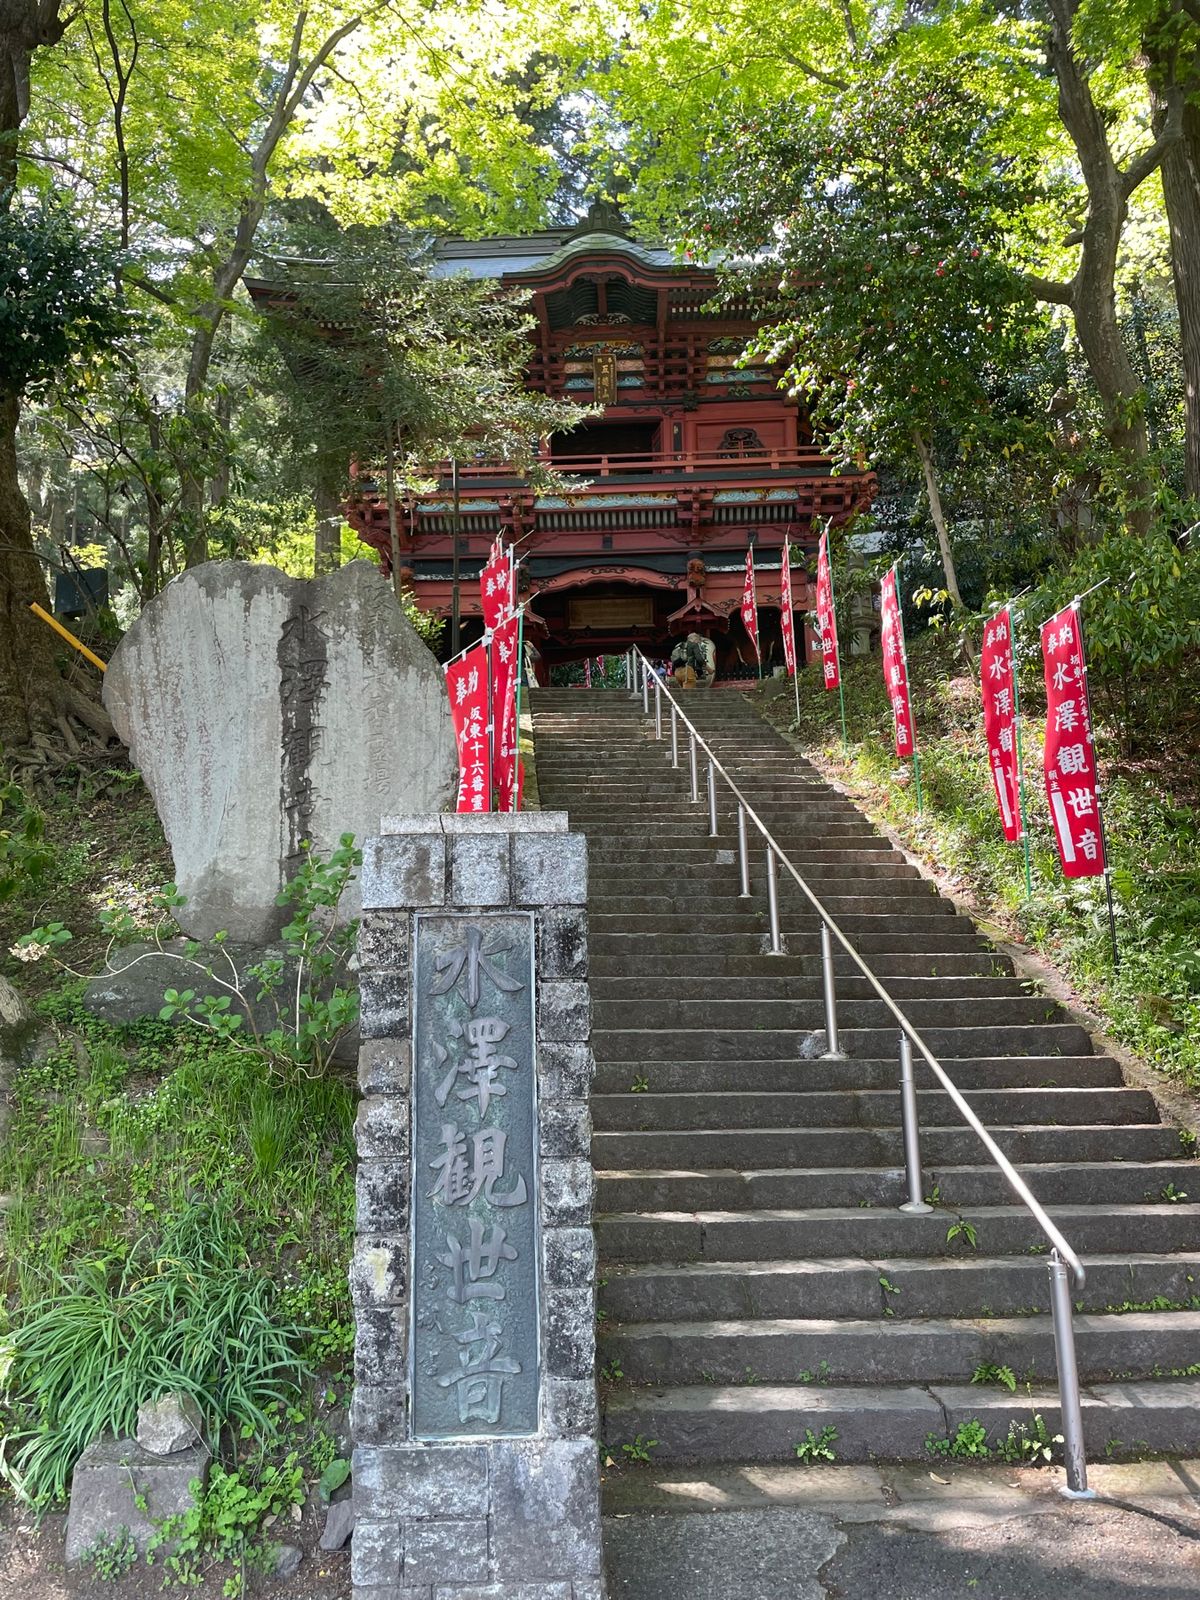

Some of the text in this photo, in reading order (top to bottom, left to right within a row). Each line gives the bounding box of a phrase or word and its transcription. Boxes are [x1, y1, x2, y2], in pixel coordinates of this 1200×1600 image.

[986, 621, 1008, 648] 奉納
[1047, 623, 1074, 655] 奉納
[456, 666, 478, 706] 奉納
[1052, 661, 1099, 860] 水澤観世音
[426, 926, 527, 1424] 水澤観世音
